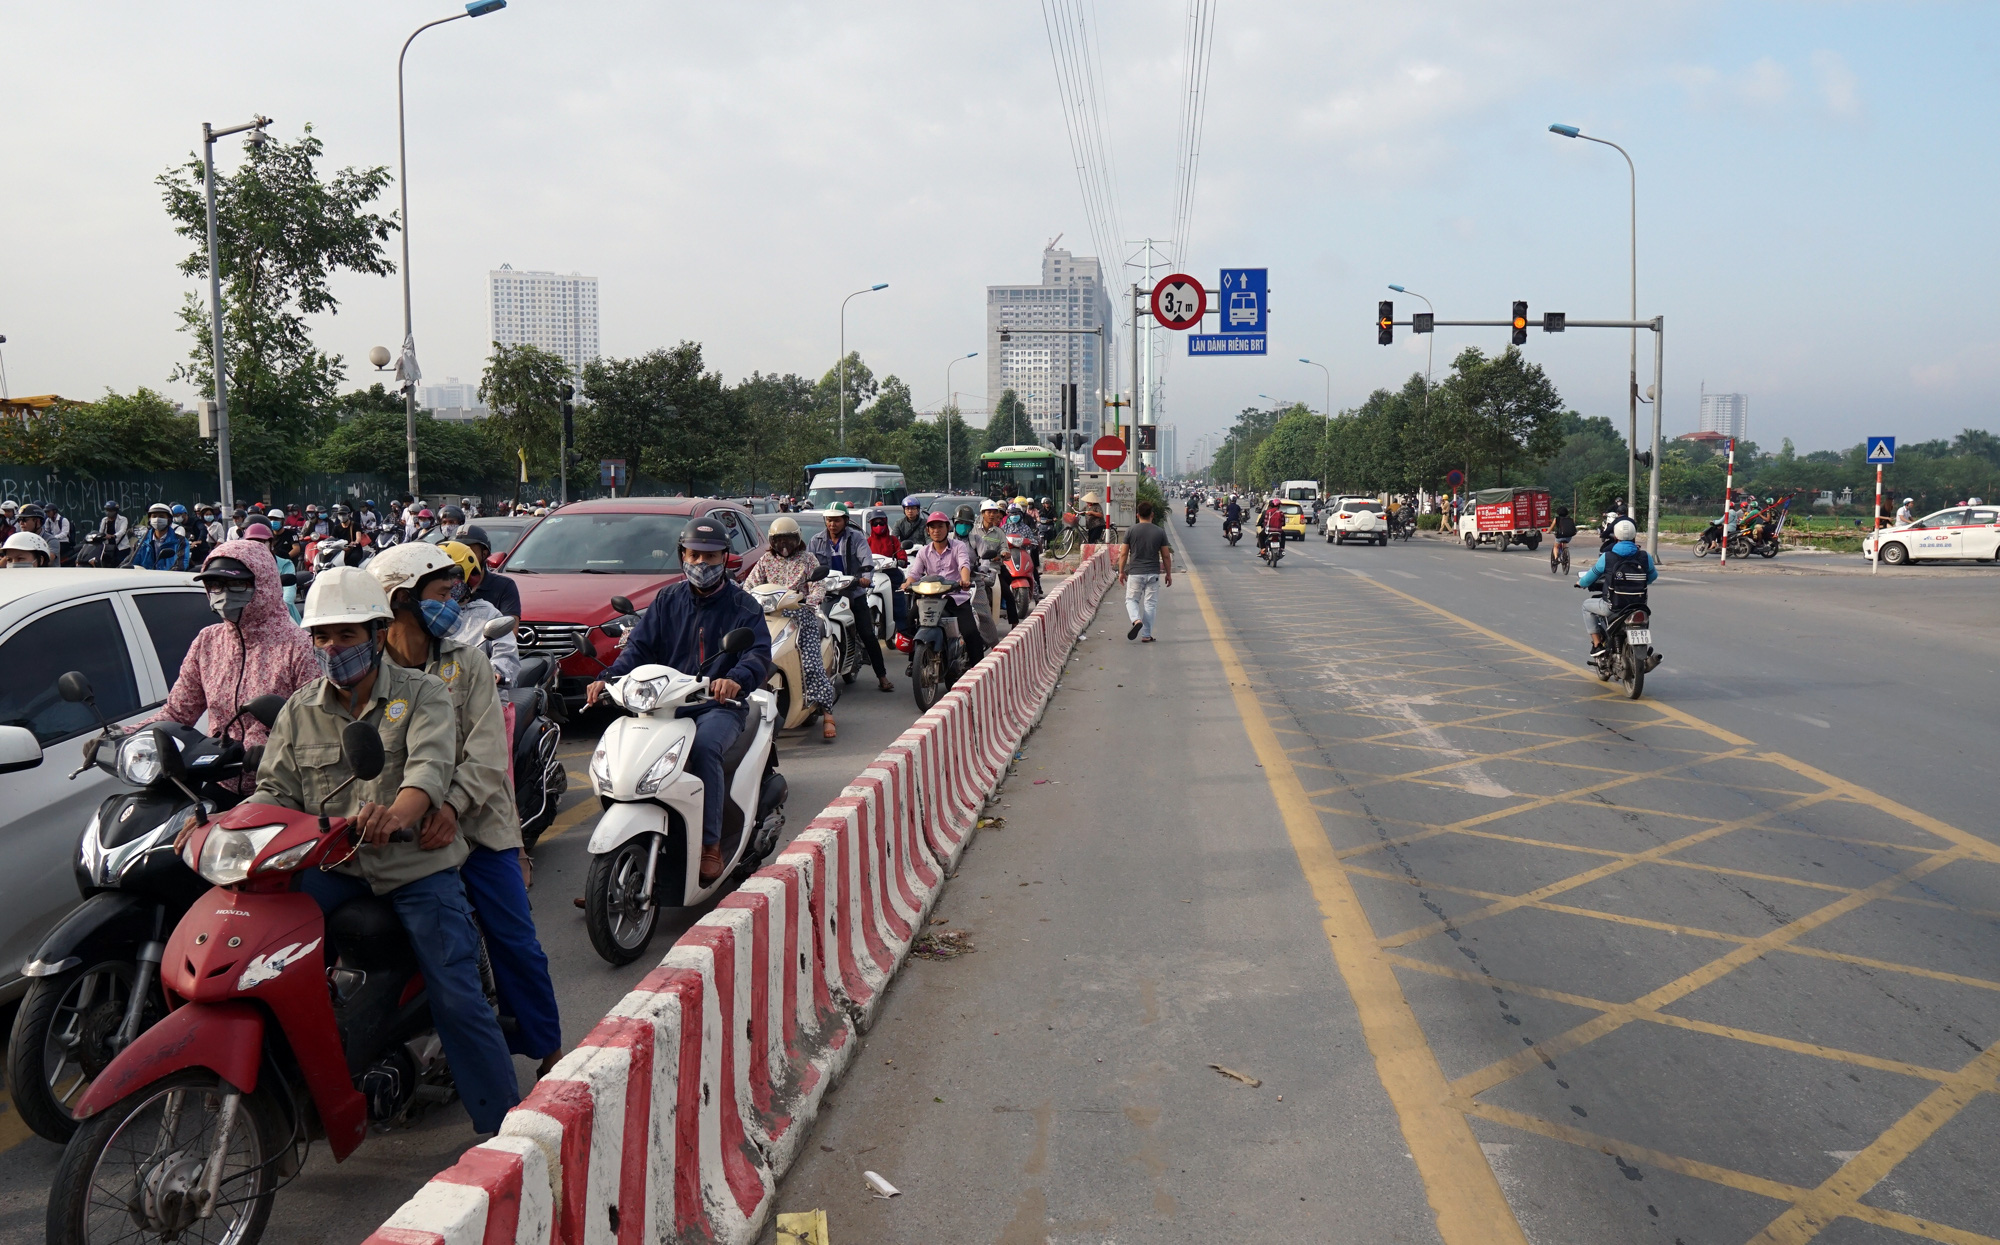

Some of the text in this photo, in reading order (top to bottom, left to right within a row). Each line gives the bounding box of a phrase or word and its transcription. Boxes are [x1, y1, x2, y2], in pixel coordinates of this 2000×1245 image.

[1164, 292, 1193, 315] 3,7 m
[1191, 336, 1264, 352] LÀN DÀNH RIÊNG BRT
[215, 909, 251, 917] HONDA
